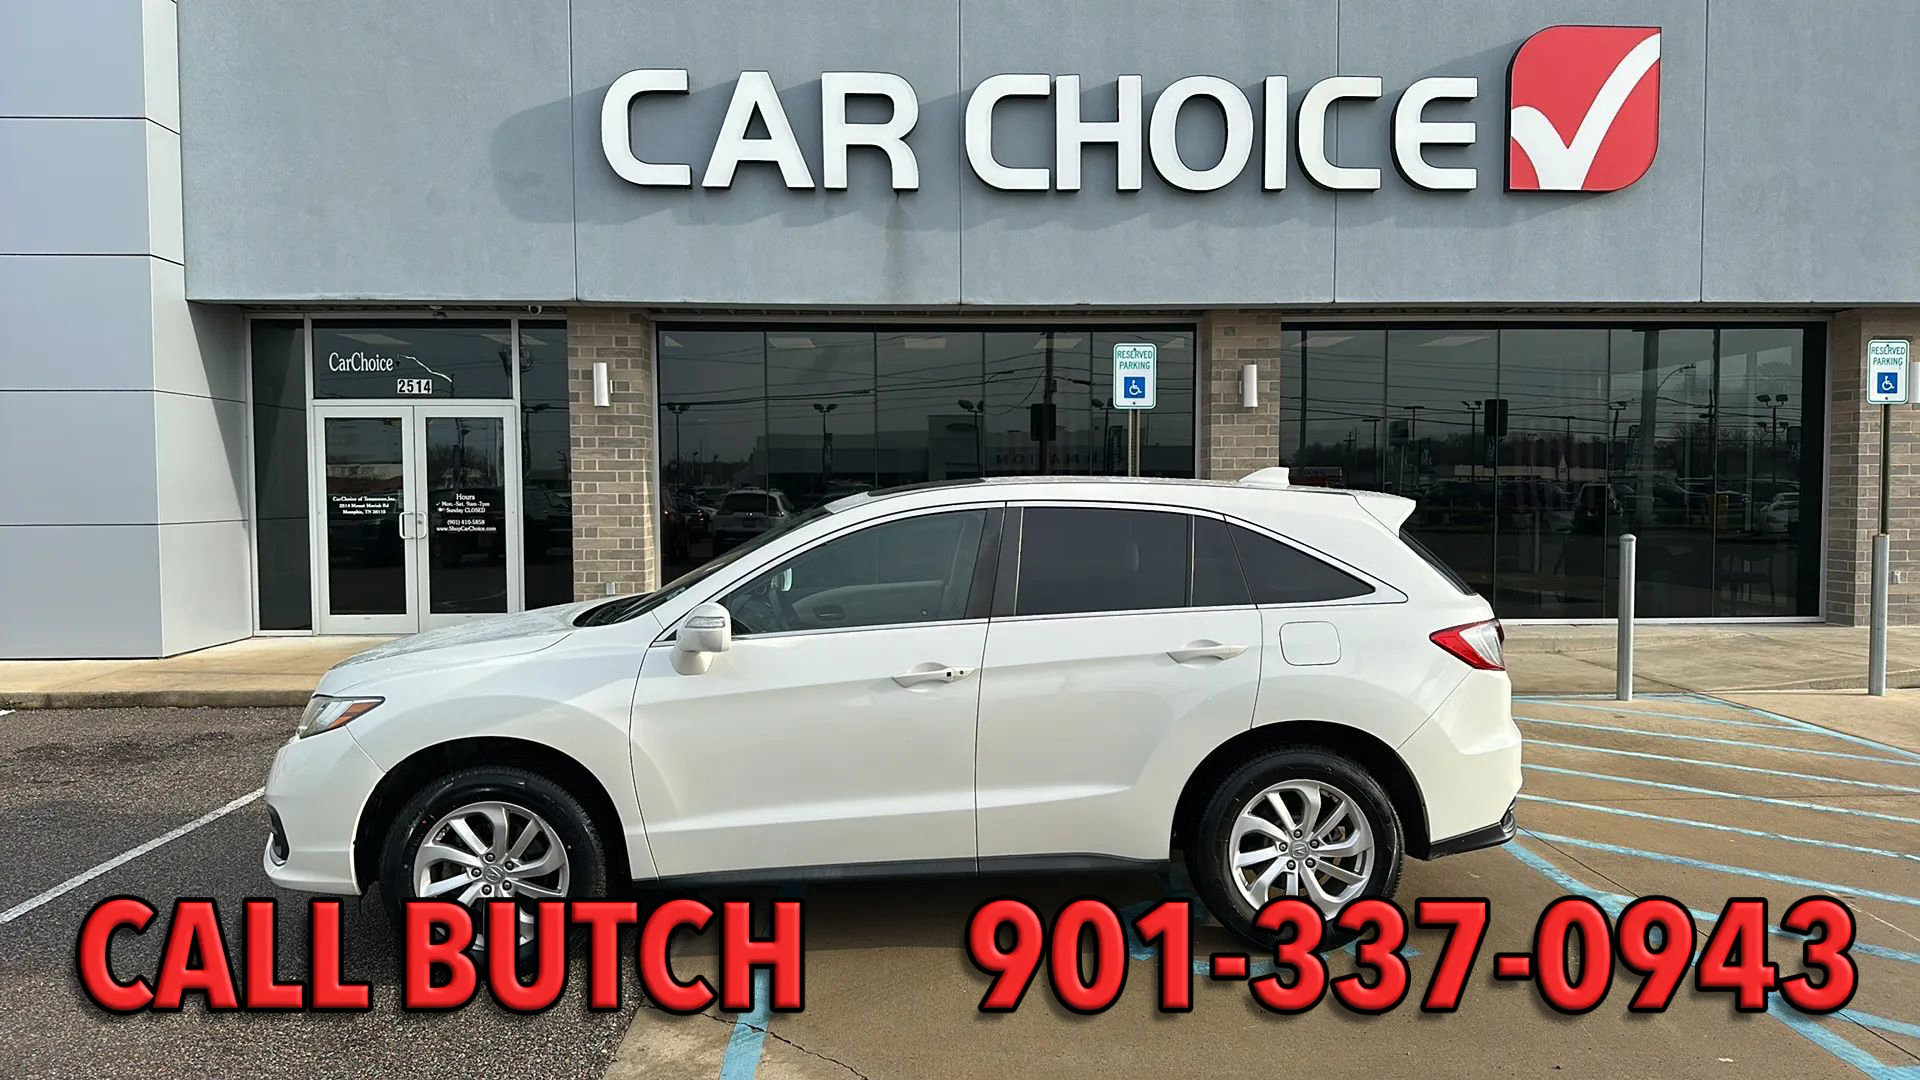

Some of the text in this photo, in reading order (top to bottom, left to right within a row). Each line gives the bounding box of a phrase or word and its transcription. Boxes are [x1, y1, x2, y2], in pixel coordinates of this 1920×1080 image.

[600, 68, 1478, 191] CAR CHOICE
[1117, 350, 1153, 359] RESERVED
[1872, 346, 1906, 355] RESERVED
[328, 351, 394, 372] CarChoice
[1119, 361, 1151, 370] PARKING
[1873, 357, 1904, 366] PARKING
[398, 379, 431, 393] 2514
